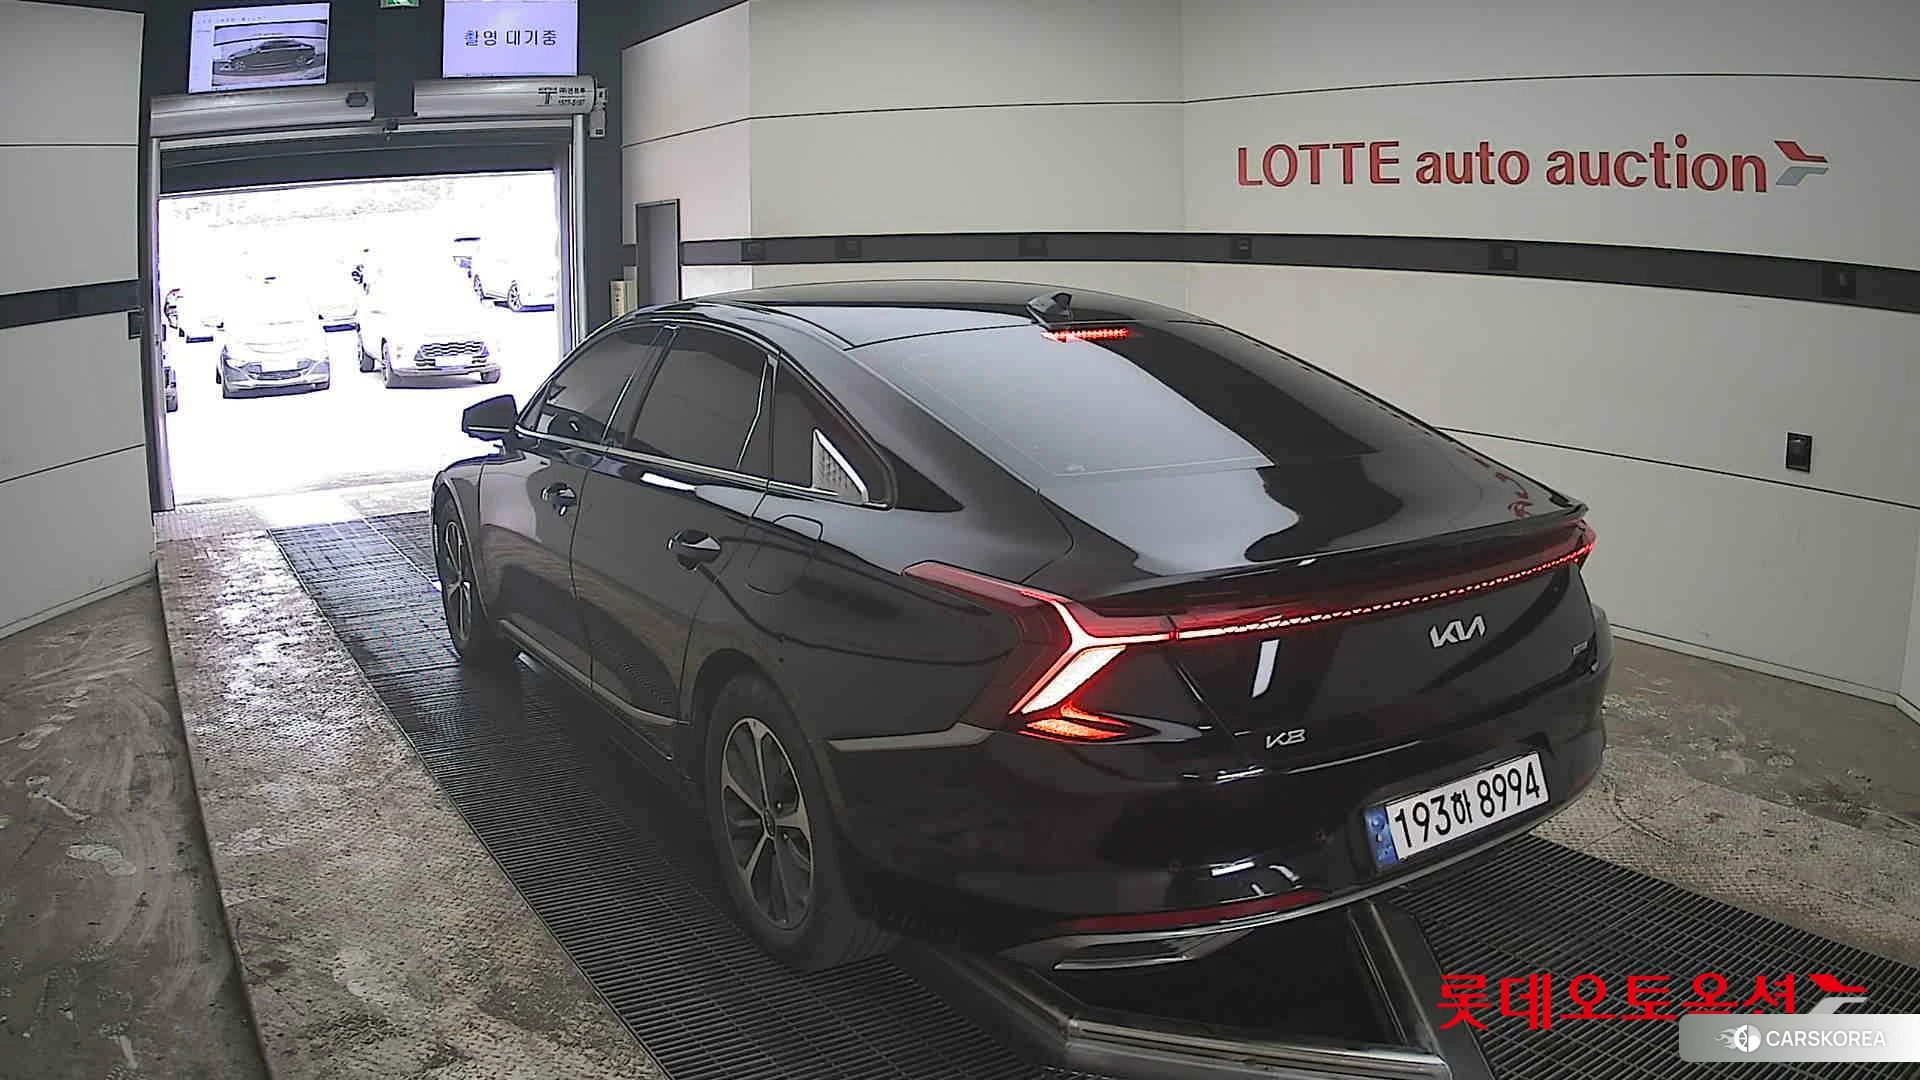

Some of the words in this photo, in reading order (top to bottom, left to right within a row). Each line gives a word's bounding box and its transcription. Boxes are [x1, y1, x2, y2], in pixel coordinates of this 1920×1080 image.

[506, 29, 558, 46] 대기중
[1237, 141, 1401, 187] LOTTE
[1415, 141, 1530, 186] auto
[1545, 133, 1768, 193] auction
[1429, 615, 1486, 649] KIA
[1264, 729, 1307, 750] K8
[1394, 789, 1473, 848] 193하
[1476, 761, 1541, 818] 8994
